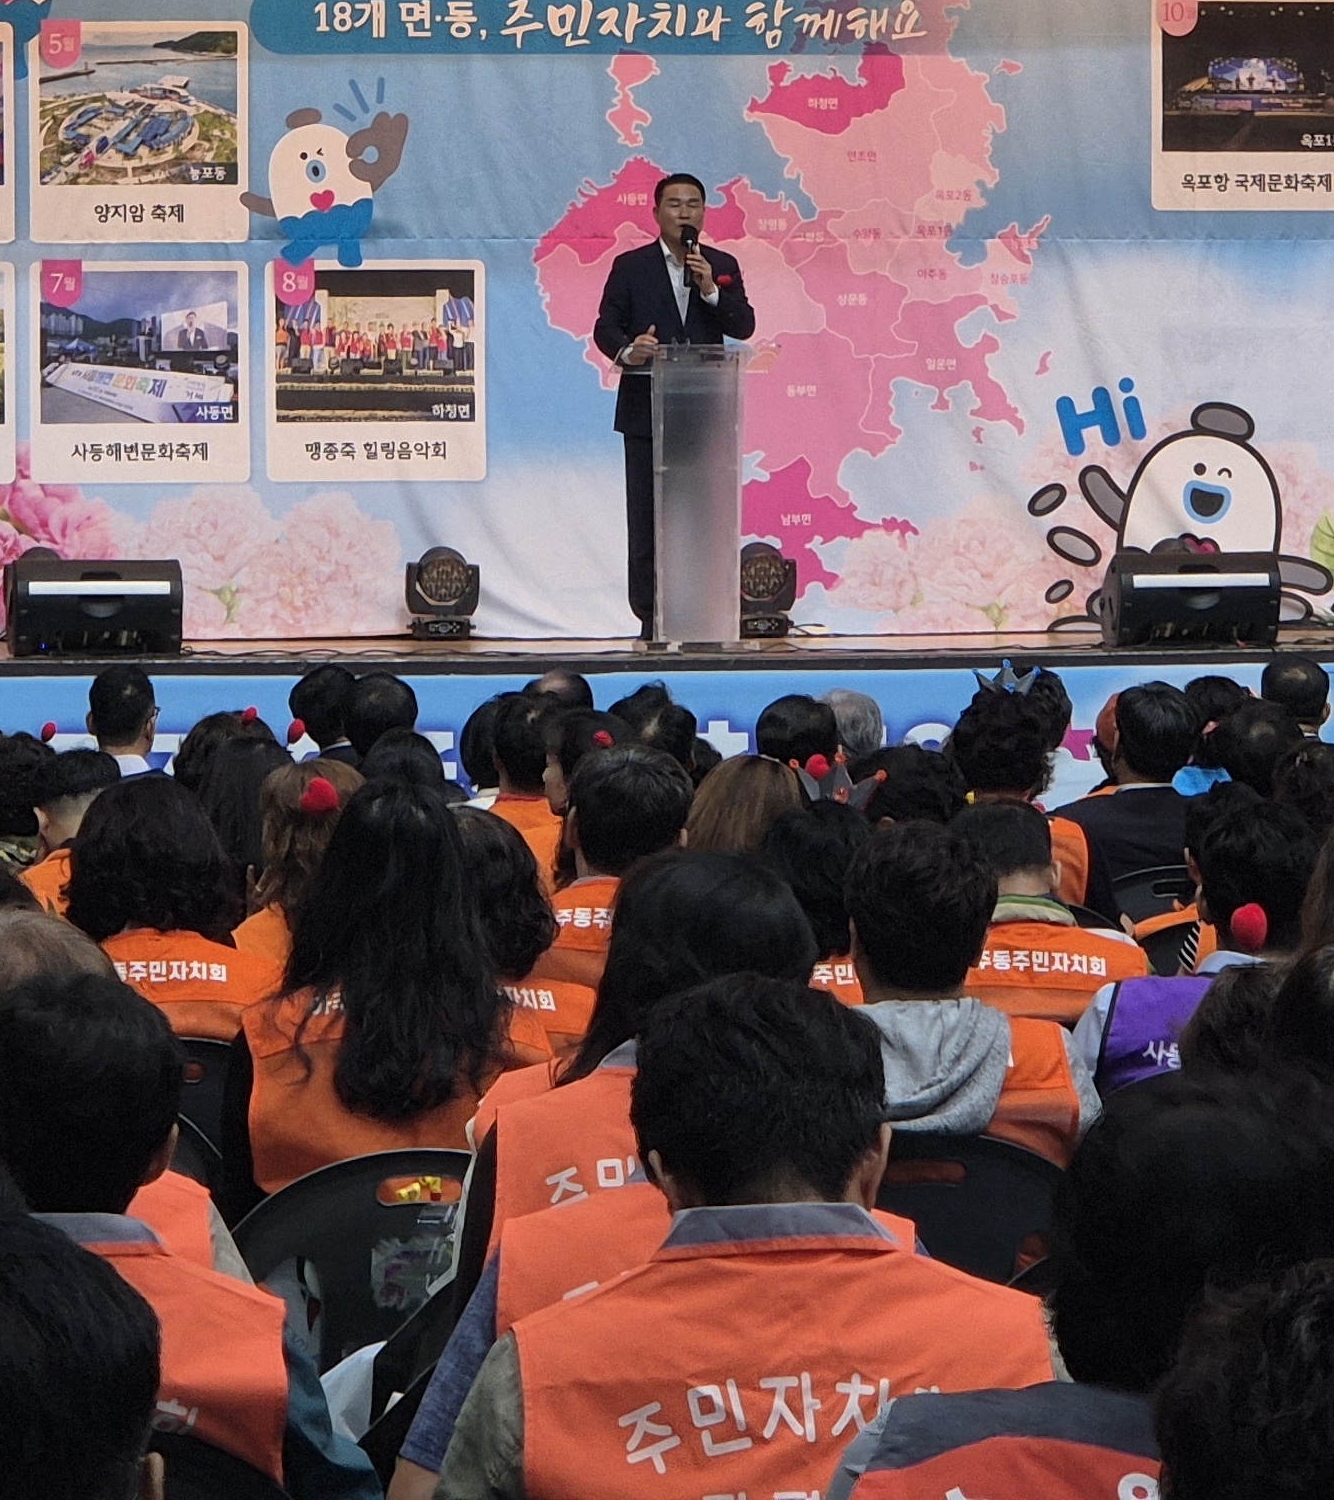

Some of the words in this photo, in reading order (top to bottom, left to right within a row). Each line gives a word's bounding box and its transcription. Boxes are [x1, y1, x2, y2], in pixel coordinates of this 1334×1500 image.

[314, 0, 385, 38] 18개
[49, 33, 75, 53] 5월
[1181, 173, 1230, 192] 옥포항
[1235, 173, 1332, 192] 국제문화축제
[94, 204, 145, 223] 양지암
[151, 204, 184, 223] 축제
[51, 272, 75, 292] 7월
[282, 272, 308, 292] 8월
[1056, 377, 1147, 457] Hi
[71, 442, 208, 462] 사등해변문화축제
[305, 441, 357, 461] 맹종죽
[363, 441, 447, 461] 힐링음악회
[618, 1371, 941, 1474] 주민자치
